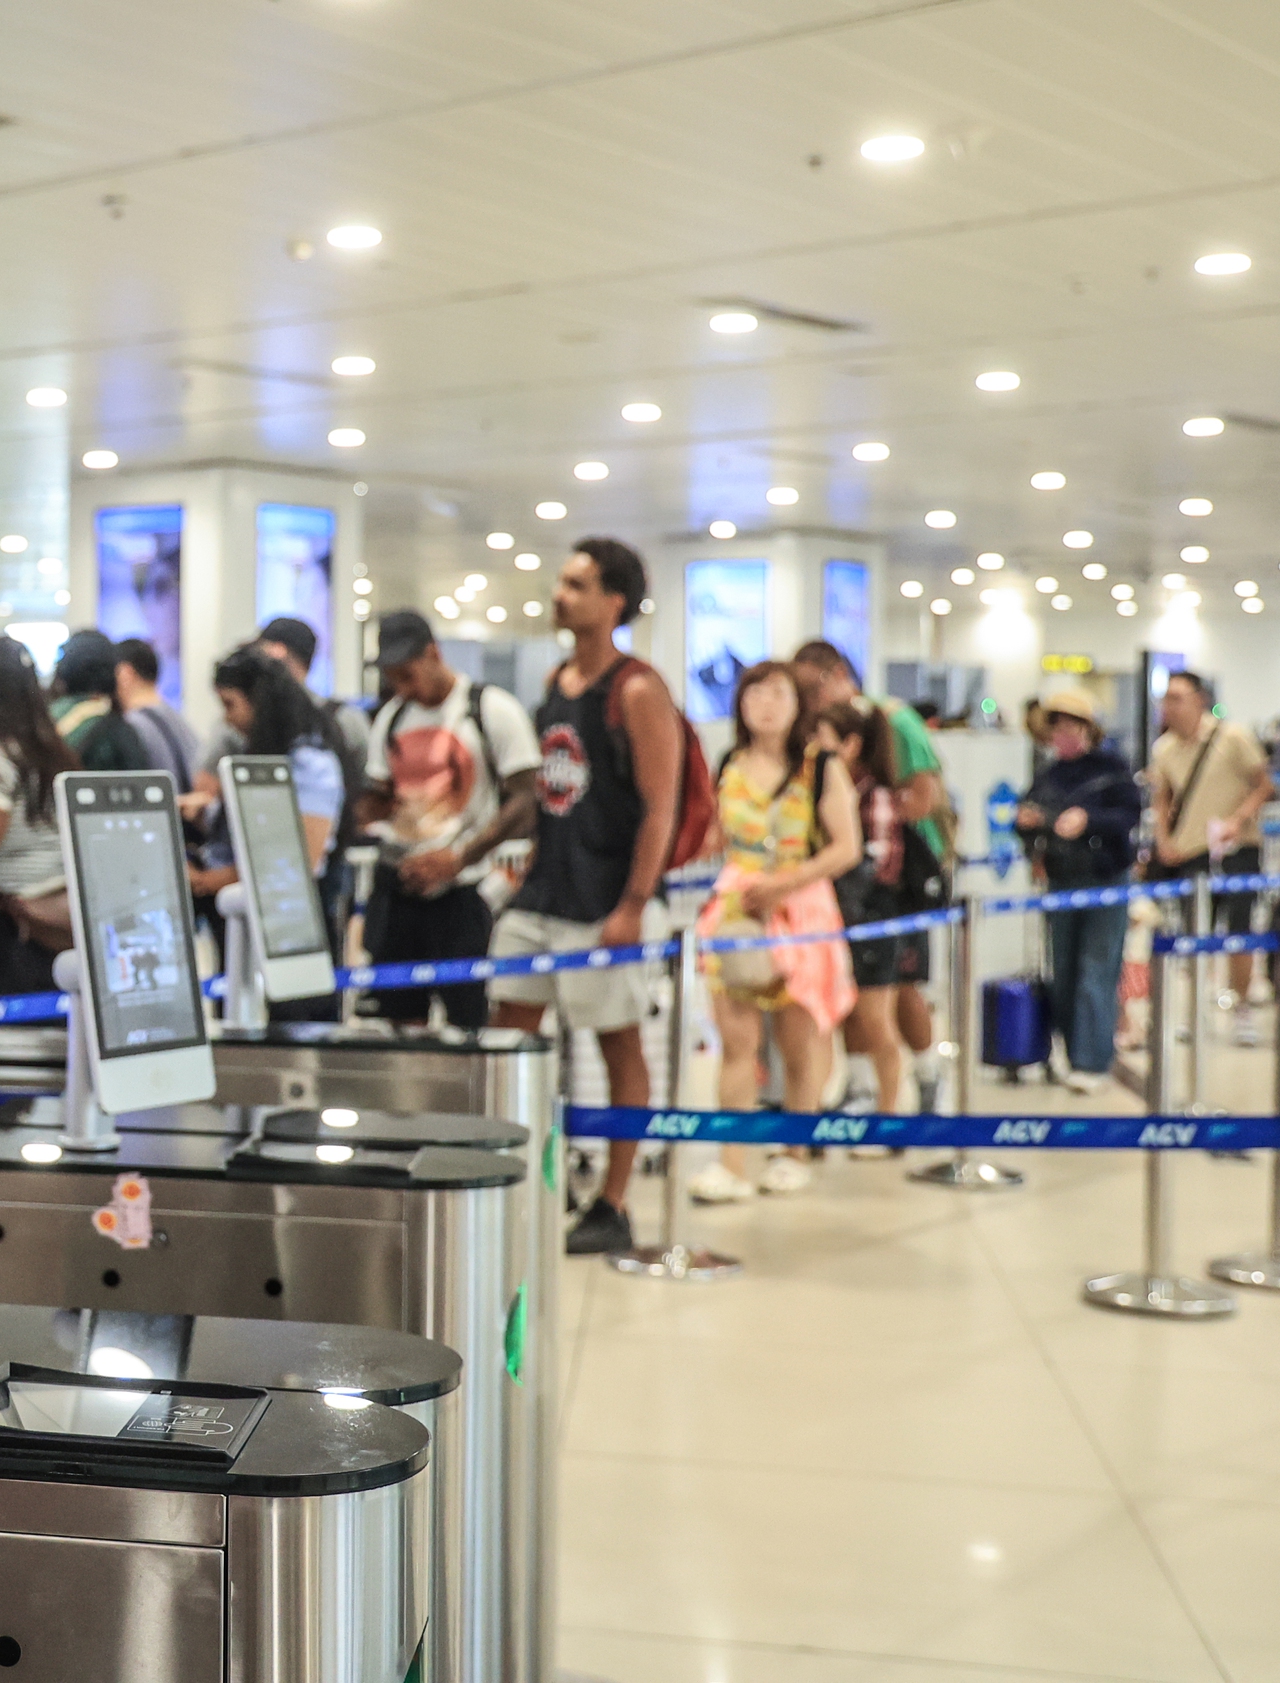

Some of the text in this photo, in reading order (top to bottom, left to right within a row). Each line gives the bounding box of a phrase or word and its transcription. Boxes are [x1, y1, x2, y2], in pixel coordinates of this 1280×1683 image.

[645, 1113, 701, 1138] ACV
[811, 1117, 869, 1142] ACV
[993, 1119, 1052, 1145] ACV
[1137, 1122, 1198, 1147] ACV
